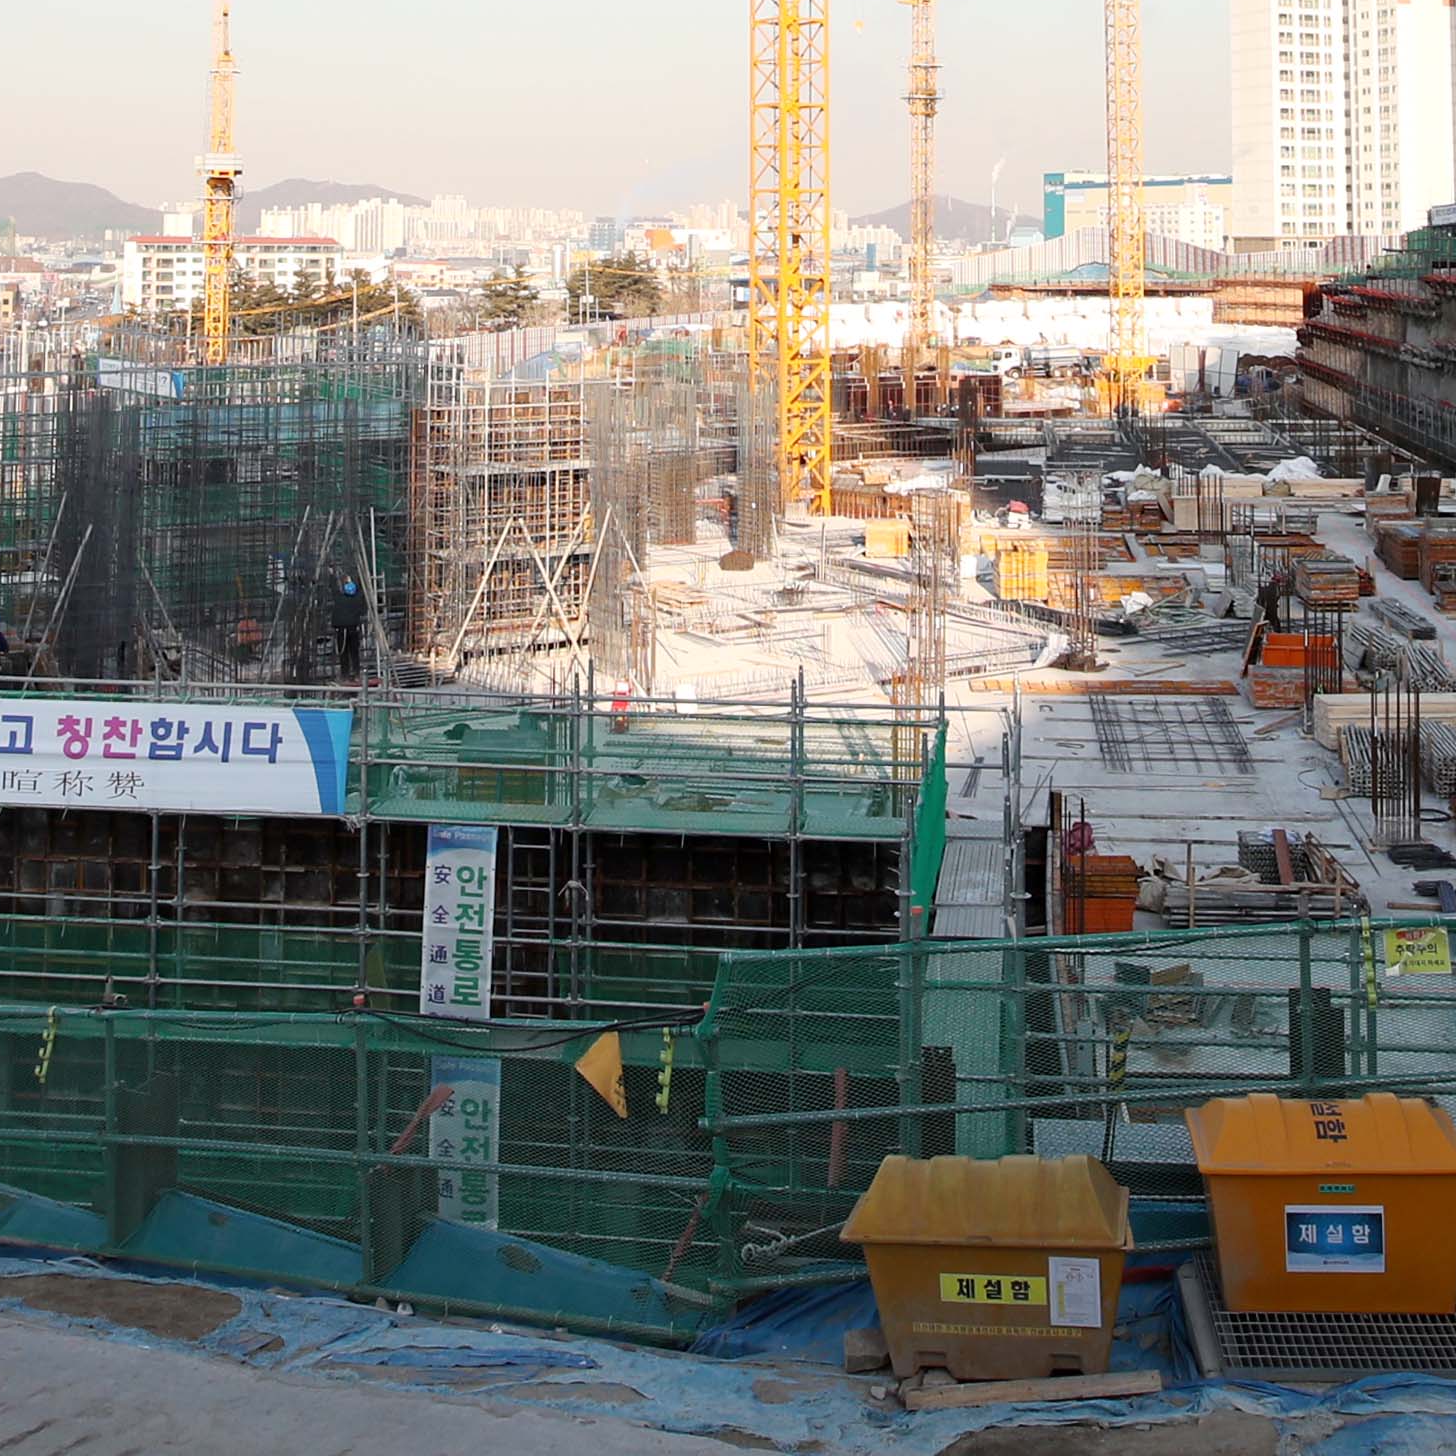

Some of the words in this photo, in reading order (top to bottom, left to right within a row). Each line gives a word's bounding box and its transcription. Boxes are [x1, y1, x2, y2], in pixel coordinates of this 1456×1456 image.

[55, 714, 284, 764] 칭찬합시다
[427, 864, 452, 1005] 安全通道
[450, 865, 488, 1007] 안전통로
[956, 1277, 1031, 1302] 제설함
